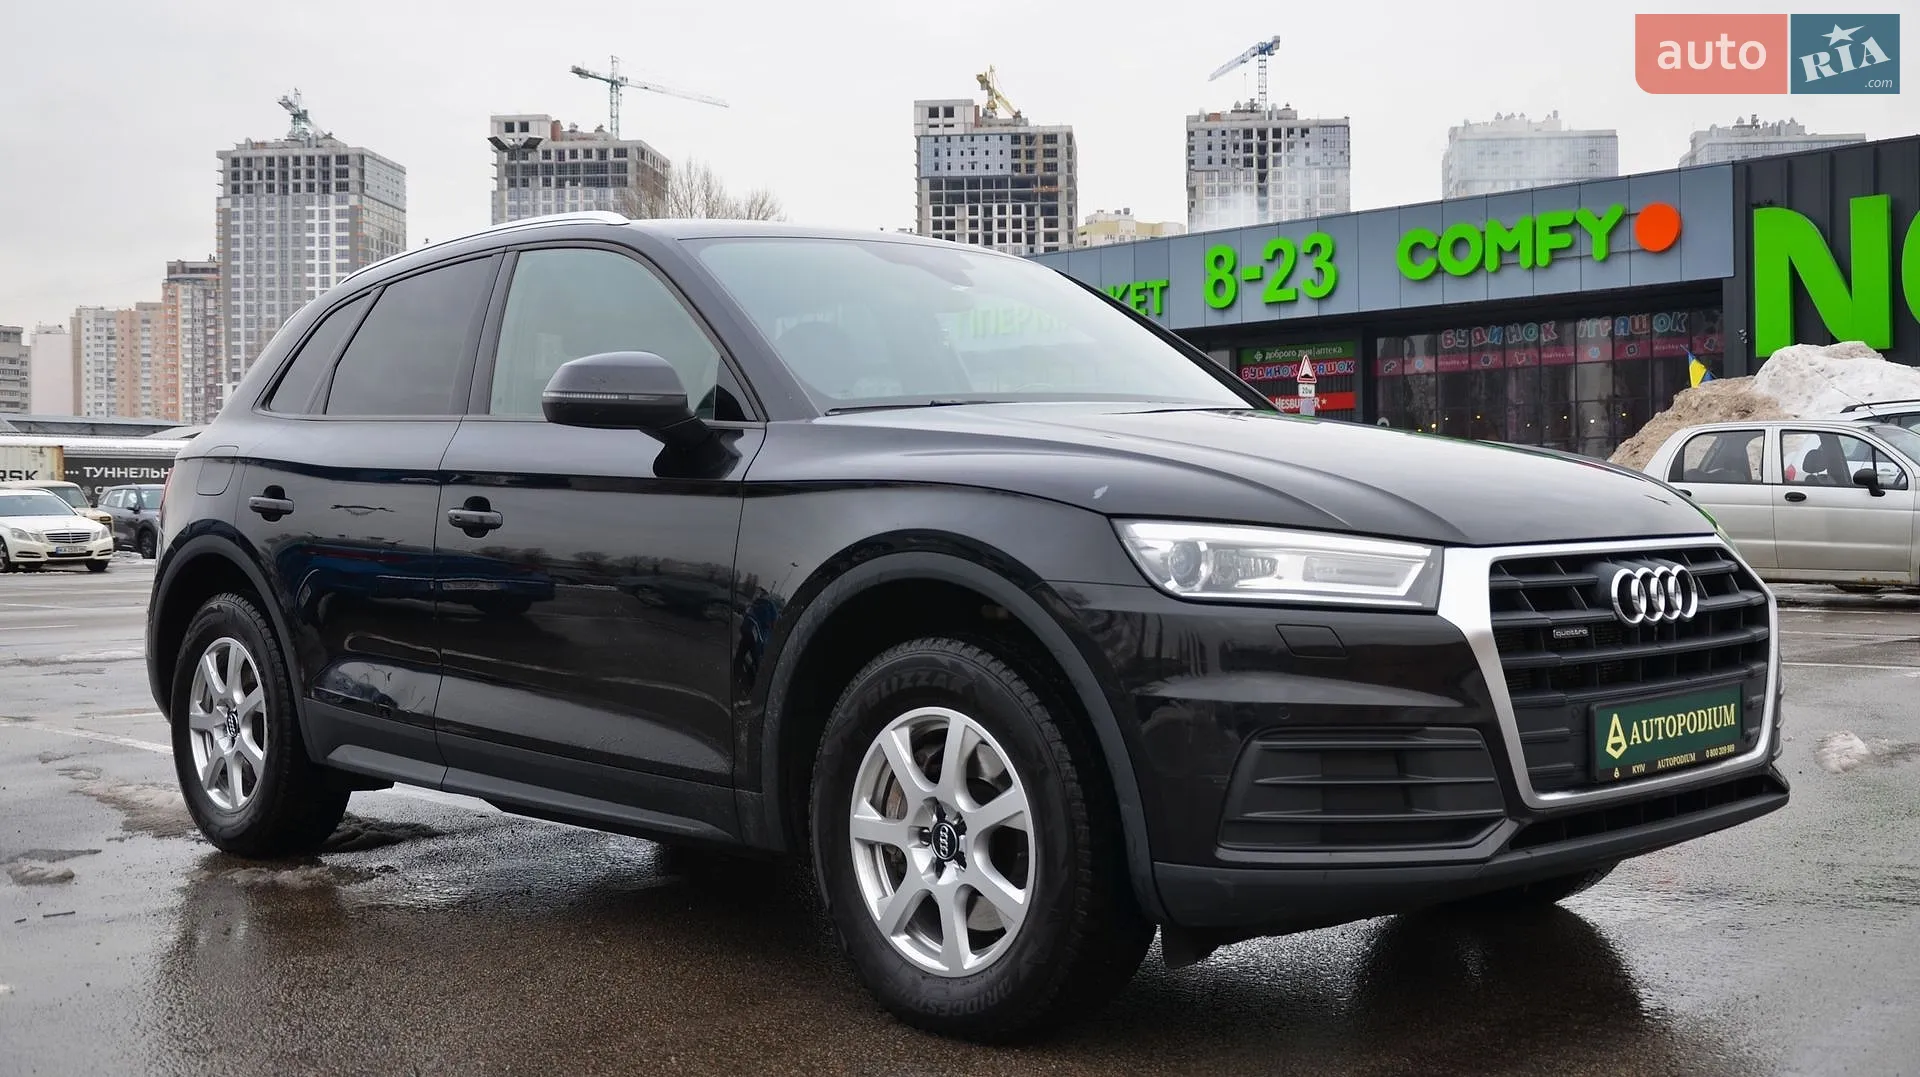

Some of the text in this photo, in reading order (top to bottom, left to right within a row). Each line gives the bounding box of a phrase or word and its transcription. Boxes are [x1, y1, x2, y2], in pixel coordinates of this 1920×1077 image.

[1396, 203, 1625, 281] COMFY
[1204, 232, 1339, 309] 8-23
[1753, 193, 1920, 358] N
[1441, 311, 1688, 349] БУДИНОК ІГРАШОК
[1241, 363, 1299, 380] БУДИНОК
[1265, 348, 1297, 360] доброго
[1315, 346, 1342, 355] аптека
[1274, 397, 1321, 409] HESBUR
[1630, 704, 1736, 745] AUTOPODIUM
[1632, 763, 1646, 775] KYIV
[1657, 752, 1696, 770] AUTOPODIUM
